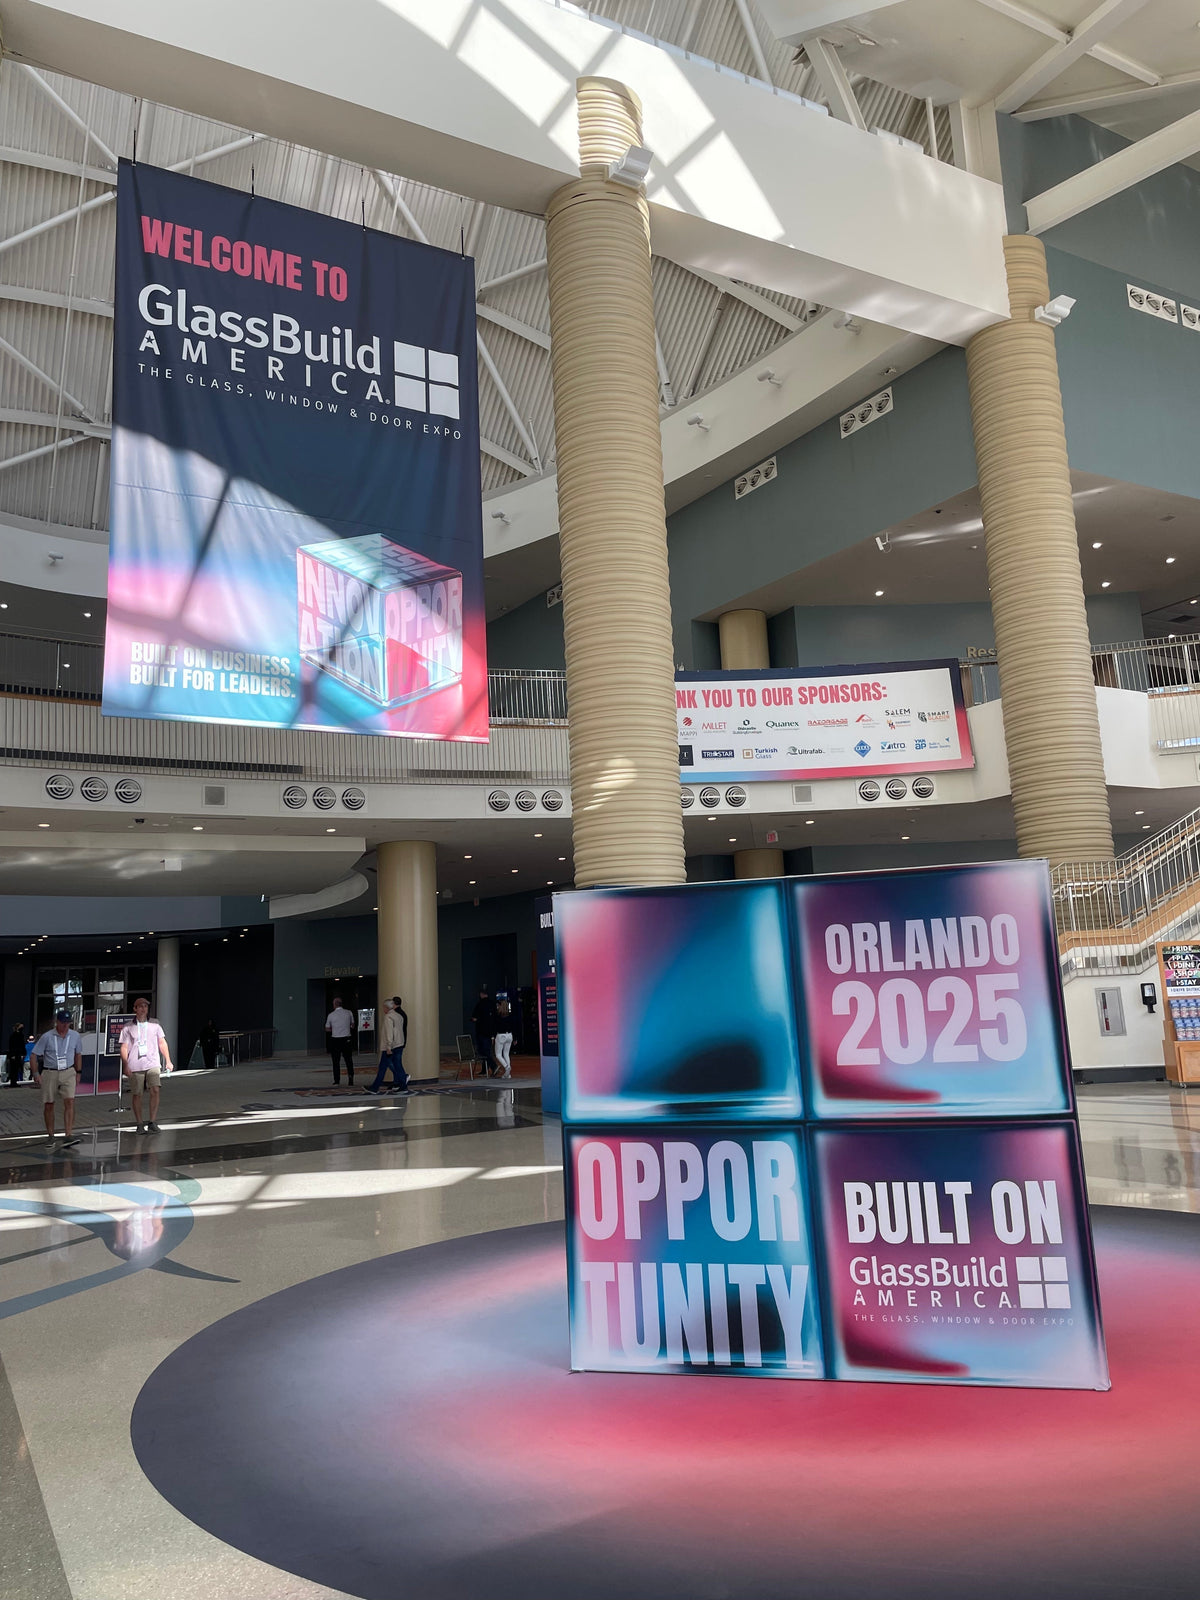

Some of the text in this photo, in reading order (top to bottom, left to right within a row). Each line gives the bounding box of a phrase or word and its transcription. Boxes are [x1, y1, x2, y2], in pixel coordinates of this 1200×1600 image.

[141, 216, 348, 302] WELCOME TO
[138, 284, 381, 375] GlassBuild
[139, 330, 384, 404] AMERICA
[138, 363, 462, 440] THE GLASS, WINDOW & DOOR EXPO
[297, 551, 380, 640] INNOV
[386, 577, 462, 645] OPPOR
[131, 642, 296, 677] BUILT ON BUSINESS.
[967, 646, 997, 658] Res
[130, 664, 296, 698] BUILT FOR LEADERS.
[676, 681, 888, 709] NK YOU TO OUR SPONSORS:
[701, 722, 727, 730] MILLET
[766, 720, 799, 729] Quanex
[885, 708, 911, 716] SALEM
[540, 912, 554, 928] BUILT
[824, 913, 1020, 974] ORLANDO
[324, 966, 361, 976] Elevator
[832, 973, 1028, 1066] 2025
[577, 1140, 801, 1242] OPPOR
[843, 1180, 1063, 1245] BUILT ON
[849, 1255, 1009, 1288] GlassBuild
[580, 1261, 809, 1369] TUNITY
[853, 1289, 1013, 1308] AMERICA
[854, 1313, 1074, 1327] THE GLASS, WINDOW & DOOR EXPO
